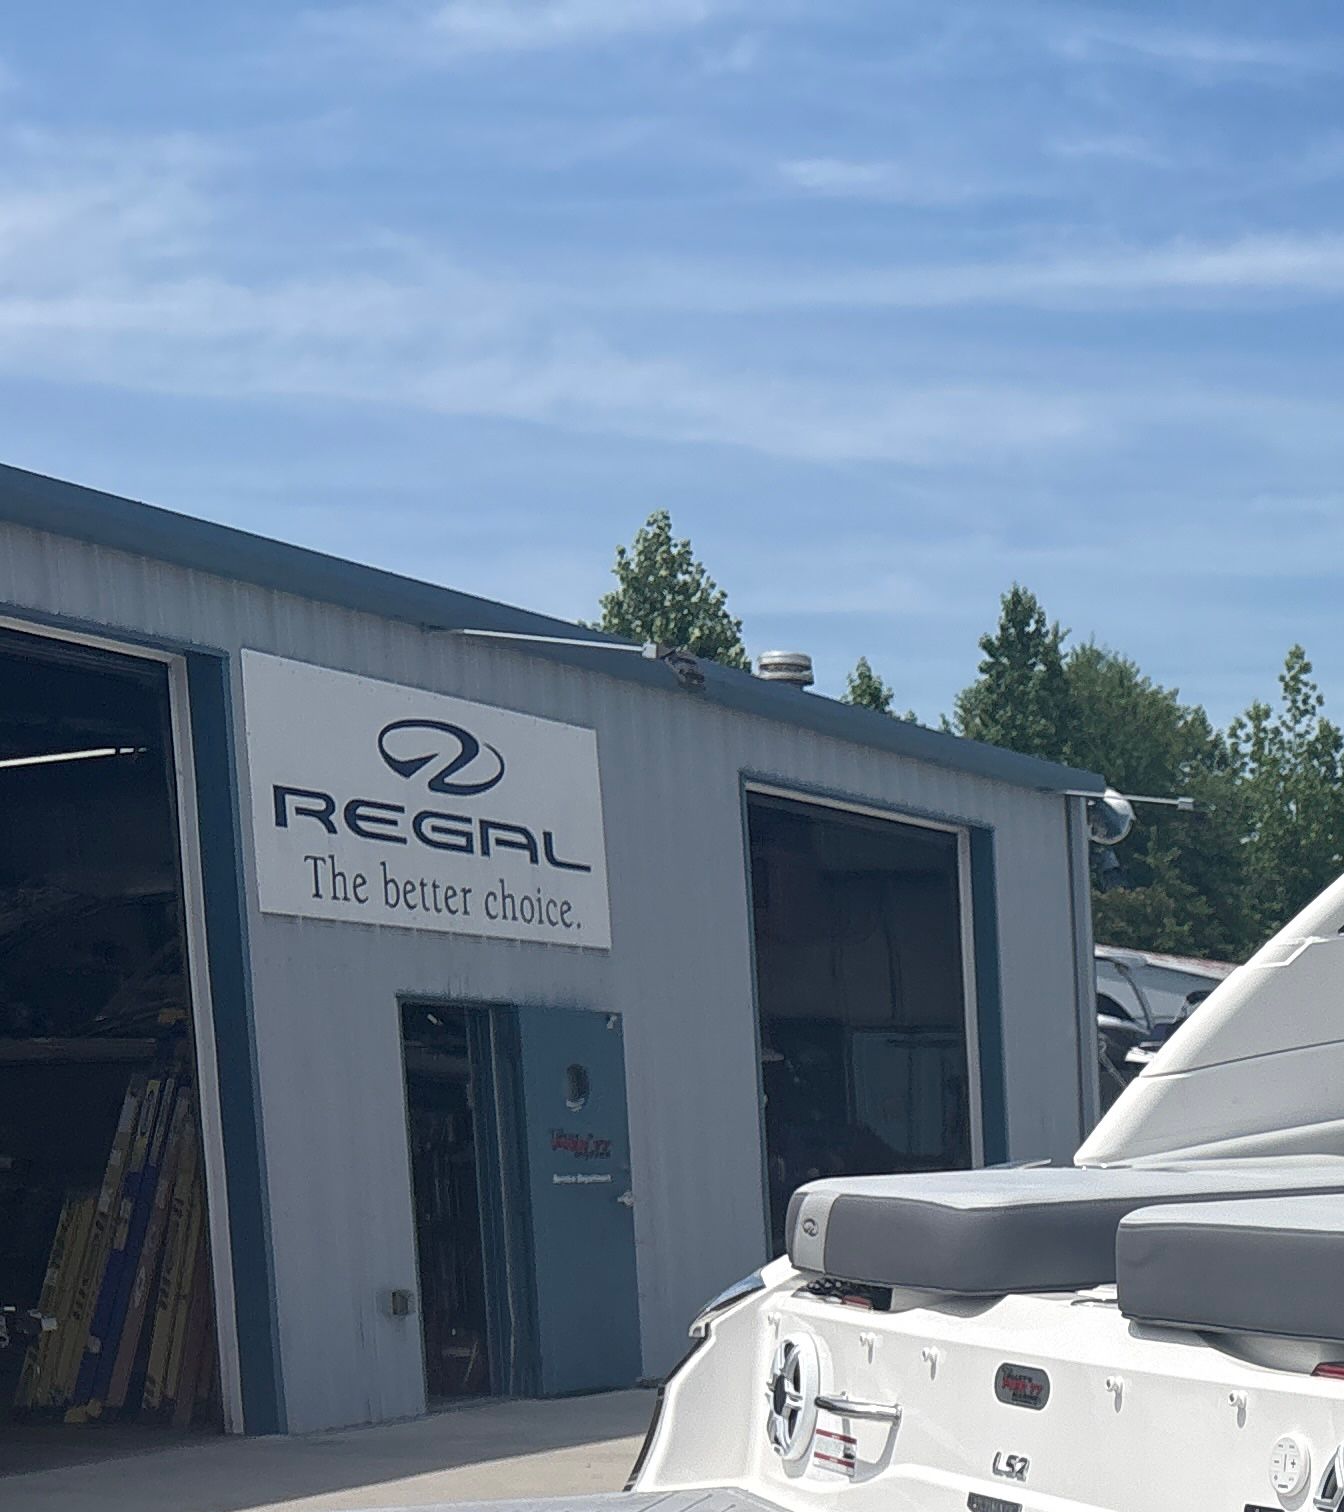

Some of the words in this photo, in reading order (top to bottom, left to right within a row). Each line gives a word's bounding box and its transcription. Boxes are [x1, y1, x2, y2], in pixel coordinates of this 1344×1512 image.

[272, 784, 591, 873] REGAL
[304, 854, 369, 904] The
[380, 861, 472, 917] better
[484, 878, 582, 929] choice.
